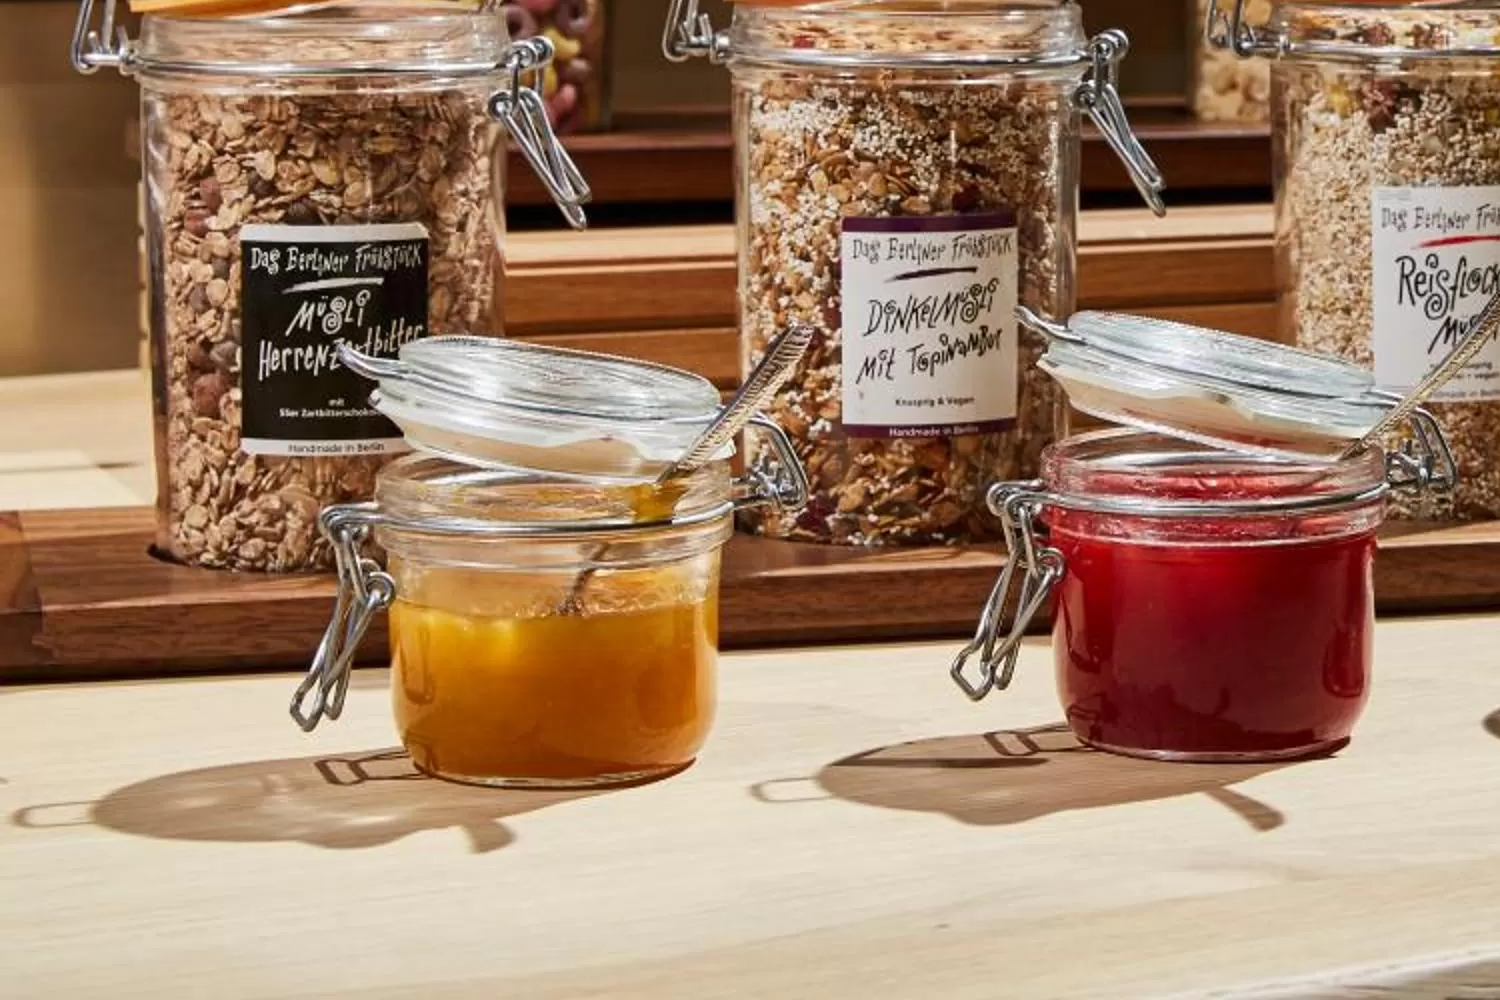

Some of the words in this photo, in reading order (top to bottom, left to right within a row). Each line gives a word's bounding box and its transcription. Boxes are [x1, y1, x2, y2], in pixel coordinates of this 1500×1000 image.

[250, 247, 281, 275] Das
[889, 426, 941, 437] Handmade
[288, 443, 342, 453] Handmade
[344, 443, 355, 451] in
[357, 441, 385, 452] Berlin
